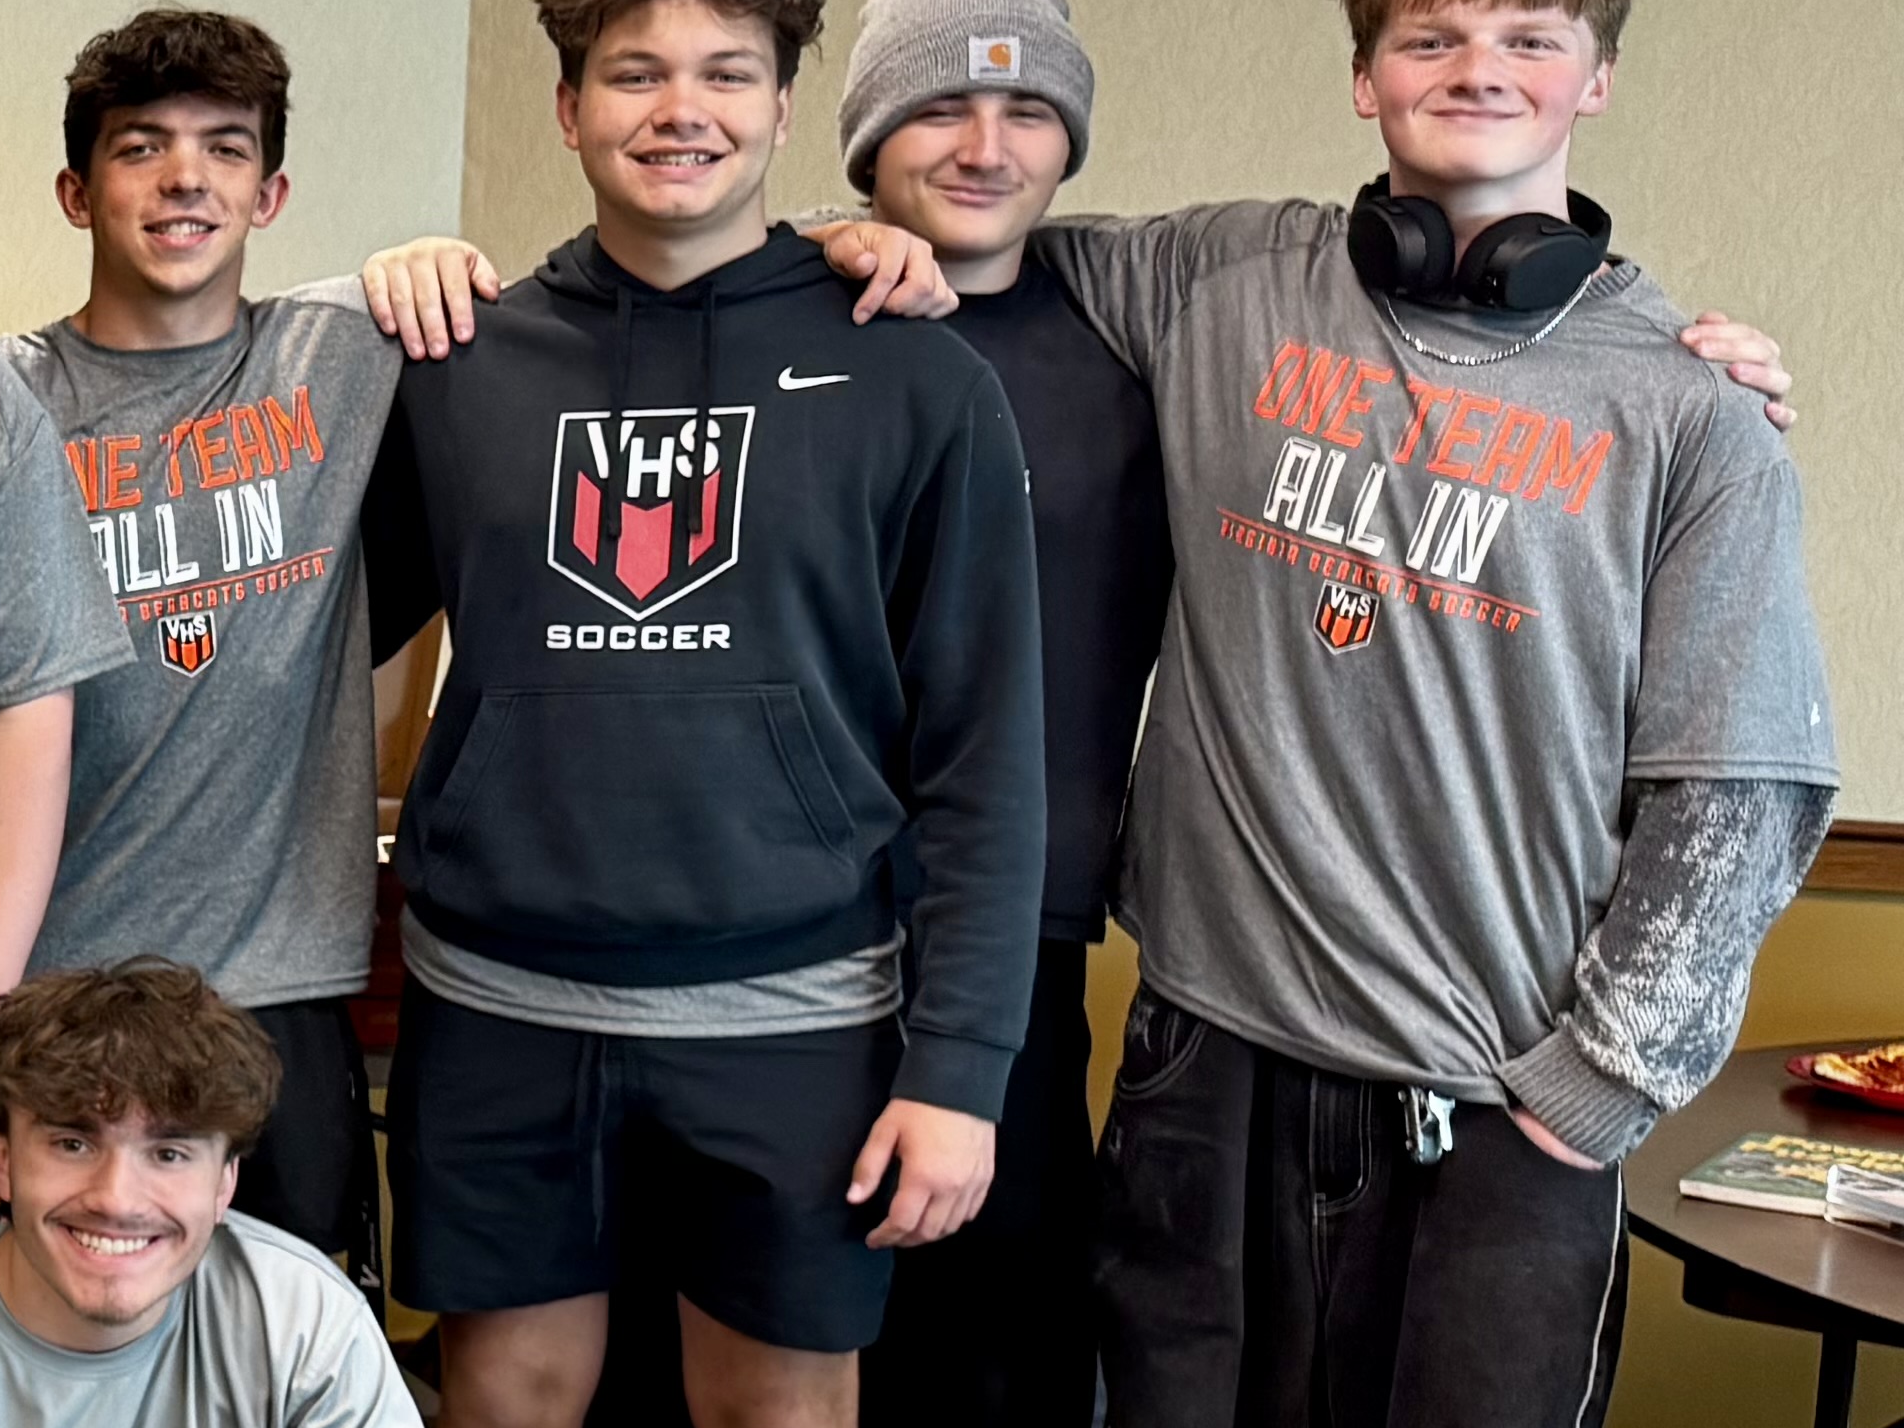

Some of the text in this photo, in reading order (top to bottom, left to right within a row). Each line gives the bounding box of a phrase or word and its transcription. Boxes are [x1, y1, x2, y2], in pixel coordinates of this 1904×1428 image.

[64, 385, 326, 513] NE TEAM
[586, 419, 722, 498] VHS
[1253, 338, 1614, 515] ONE TEAM
[214, 479, 284, 572] IN
[1262, 436, 1510, 584] ALL IN
[165, 613, 208, 644] VHS
[546, 623, 732, 651] SOCCER
[1330, 585, 1373, 619] VHS
